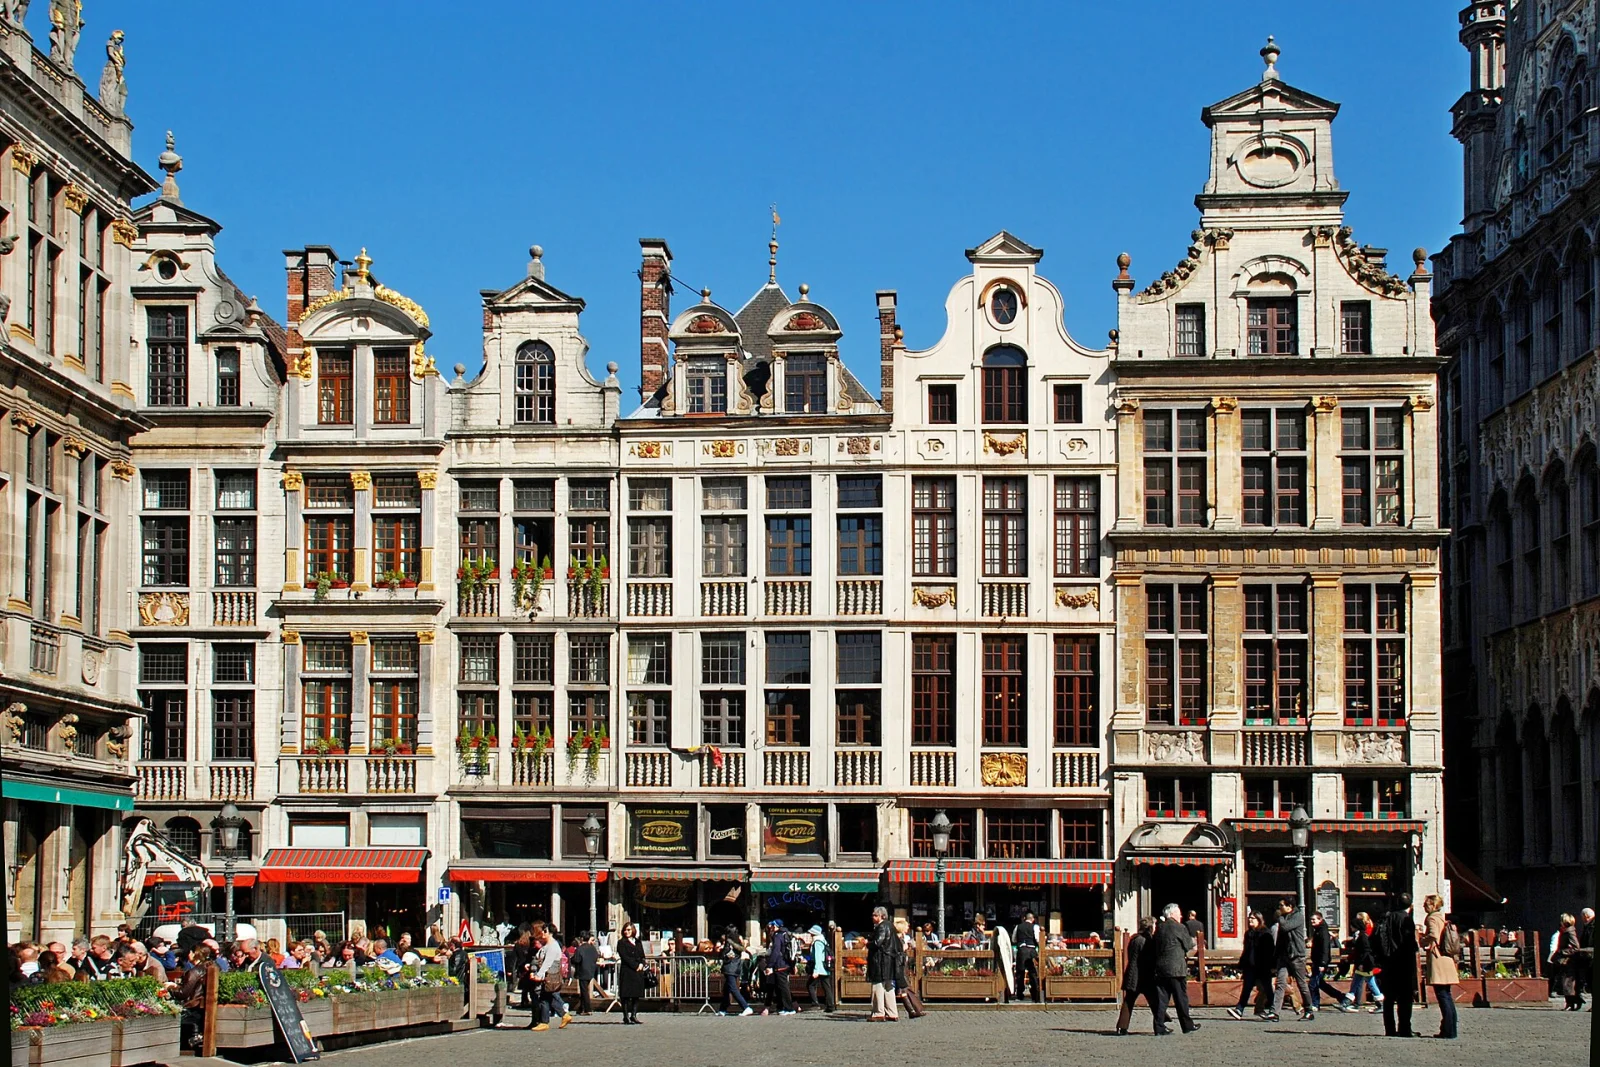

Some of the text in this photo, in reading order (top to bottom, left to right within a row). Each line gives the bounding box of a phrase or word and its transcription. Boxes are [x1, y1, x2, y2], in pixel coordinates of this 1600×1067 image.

[927, 439, 1084, 452] 16 97
[642, 825, 682, 836] aroma
[775, 826, 816, 837] aroma
[285, 870, 392, 880] the Belgian chocolates
[788, 882, 840, 891] EL GRECO
[768, 892, 825, 911] EL GRECO
